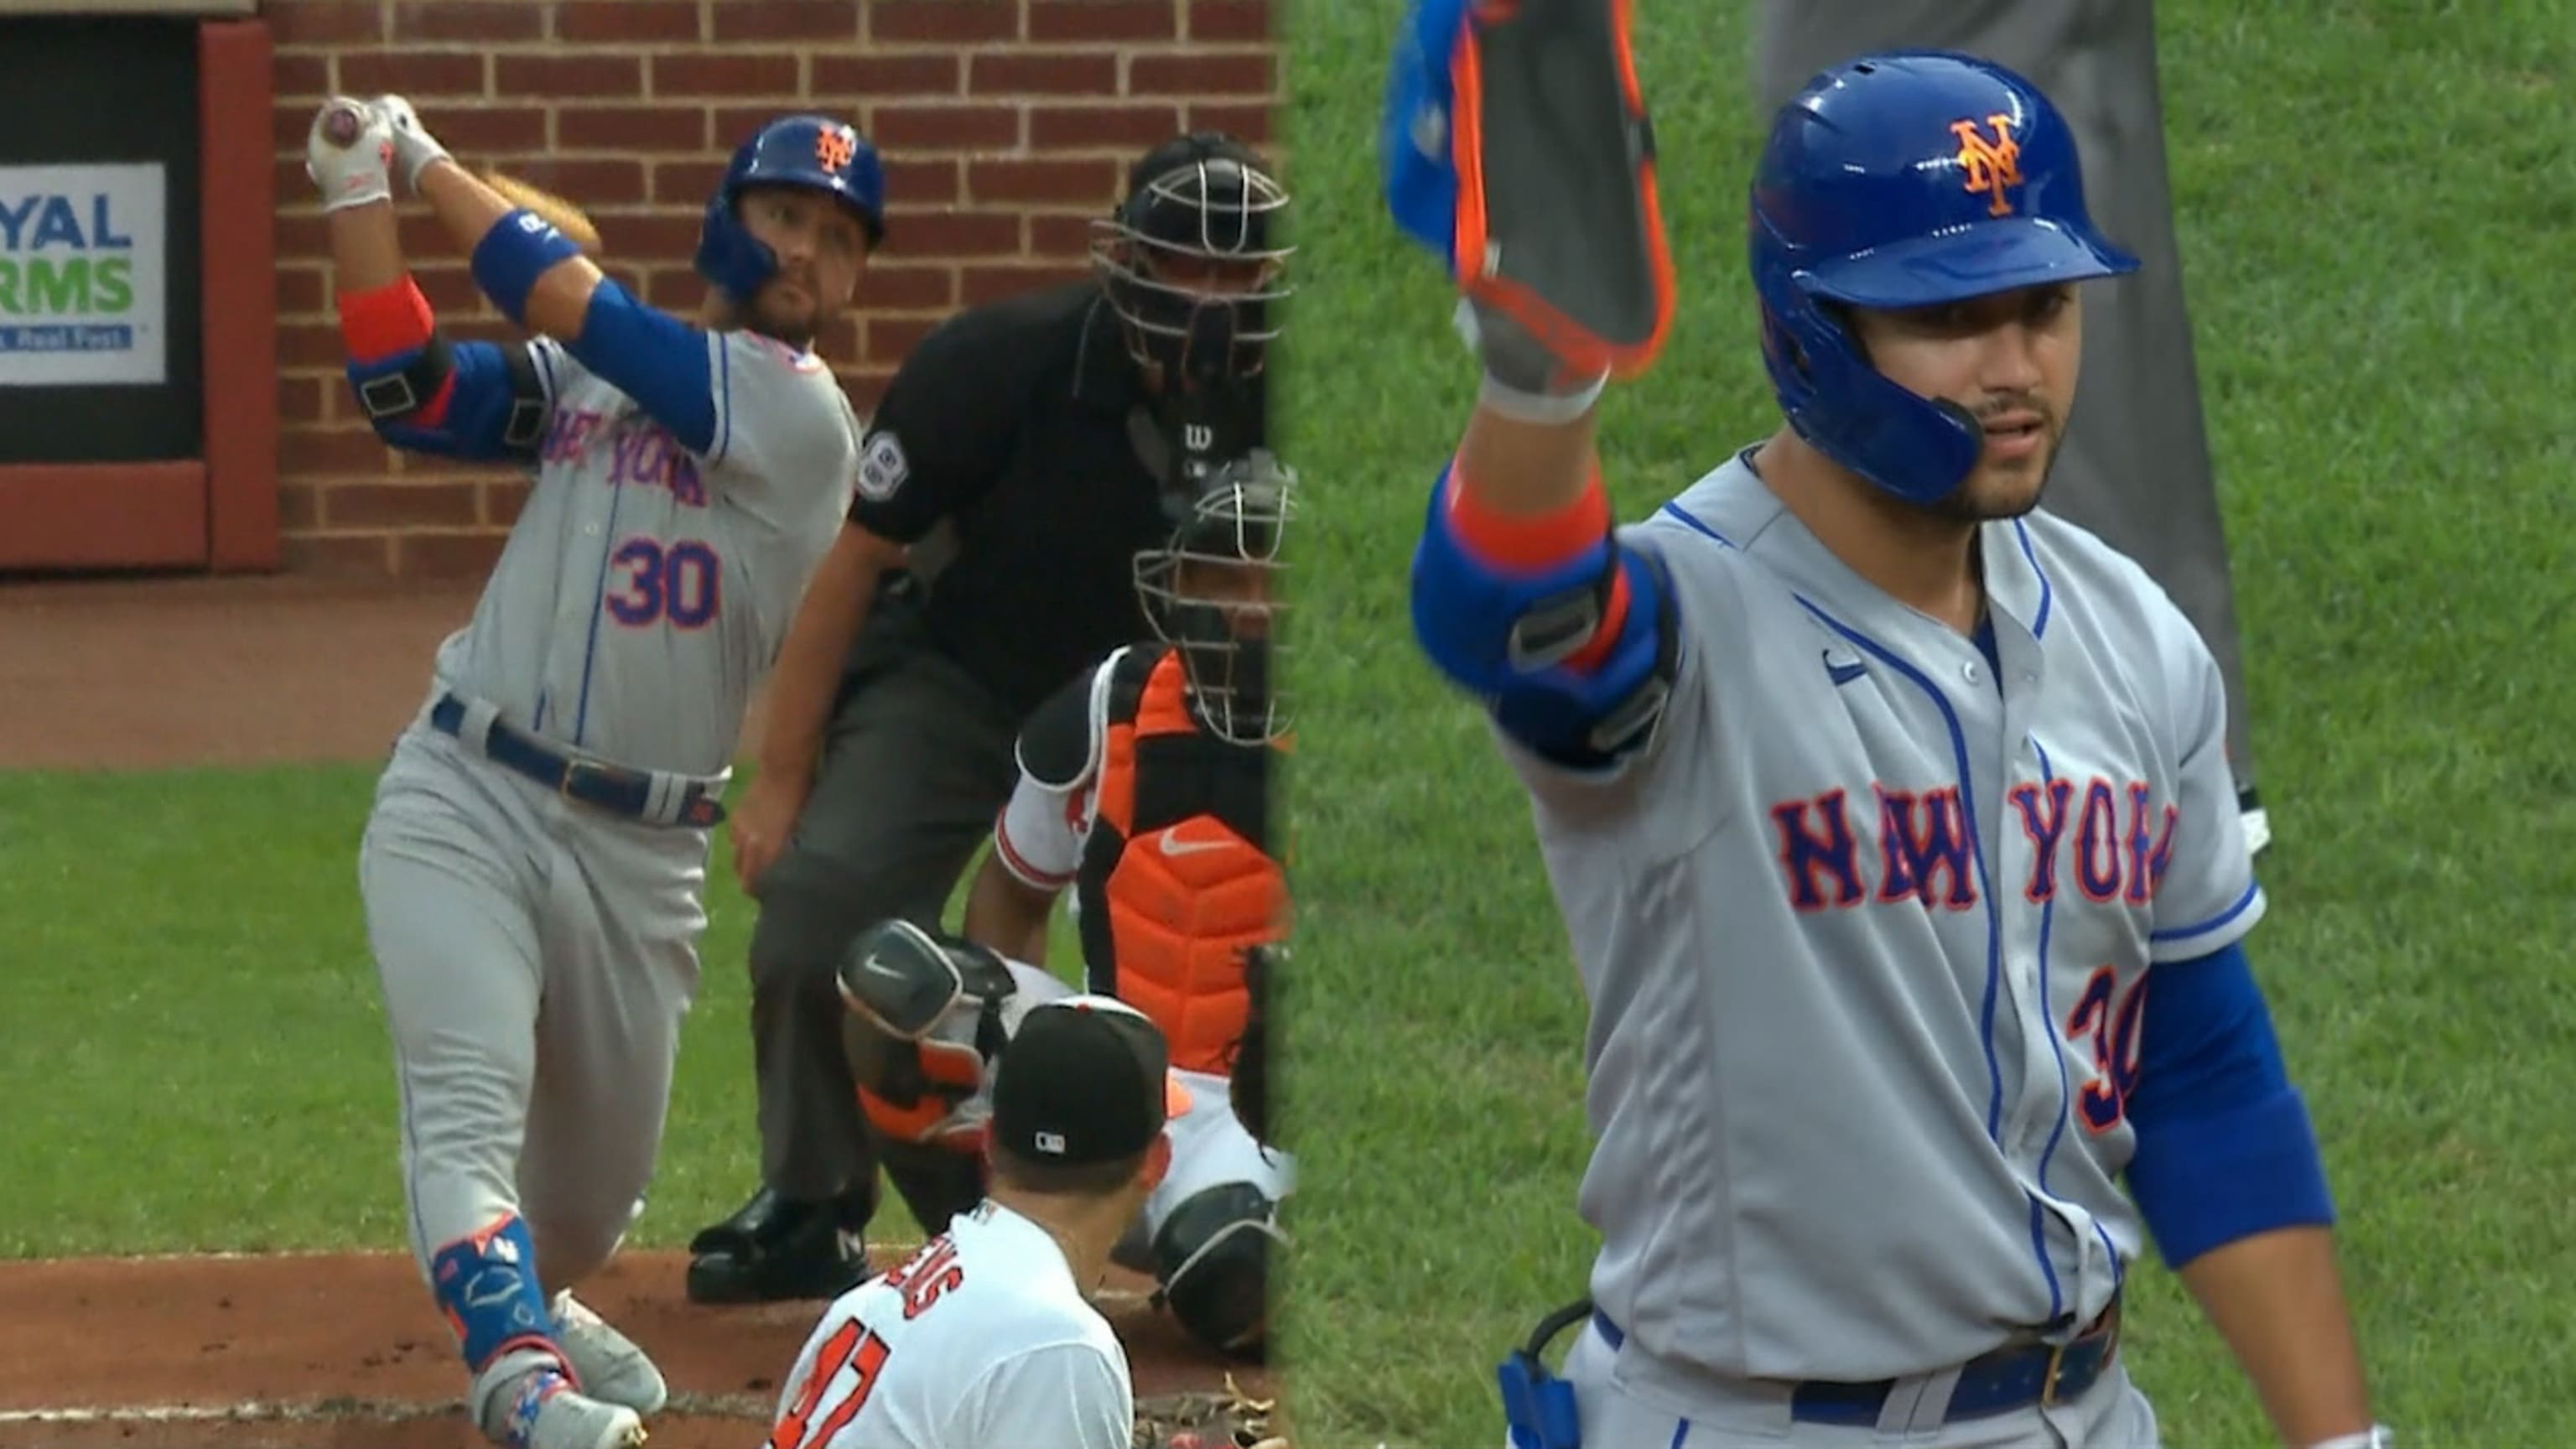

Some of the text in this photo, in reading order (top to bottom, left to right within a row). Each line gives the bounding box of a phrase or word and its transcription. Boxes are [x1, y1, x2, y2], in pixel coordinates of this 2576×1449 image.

[1950, 114, 2023, 216] NY
[0, 194, 132, 250] YAL
[605, 536, 722, 630] 30
